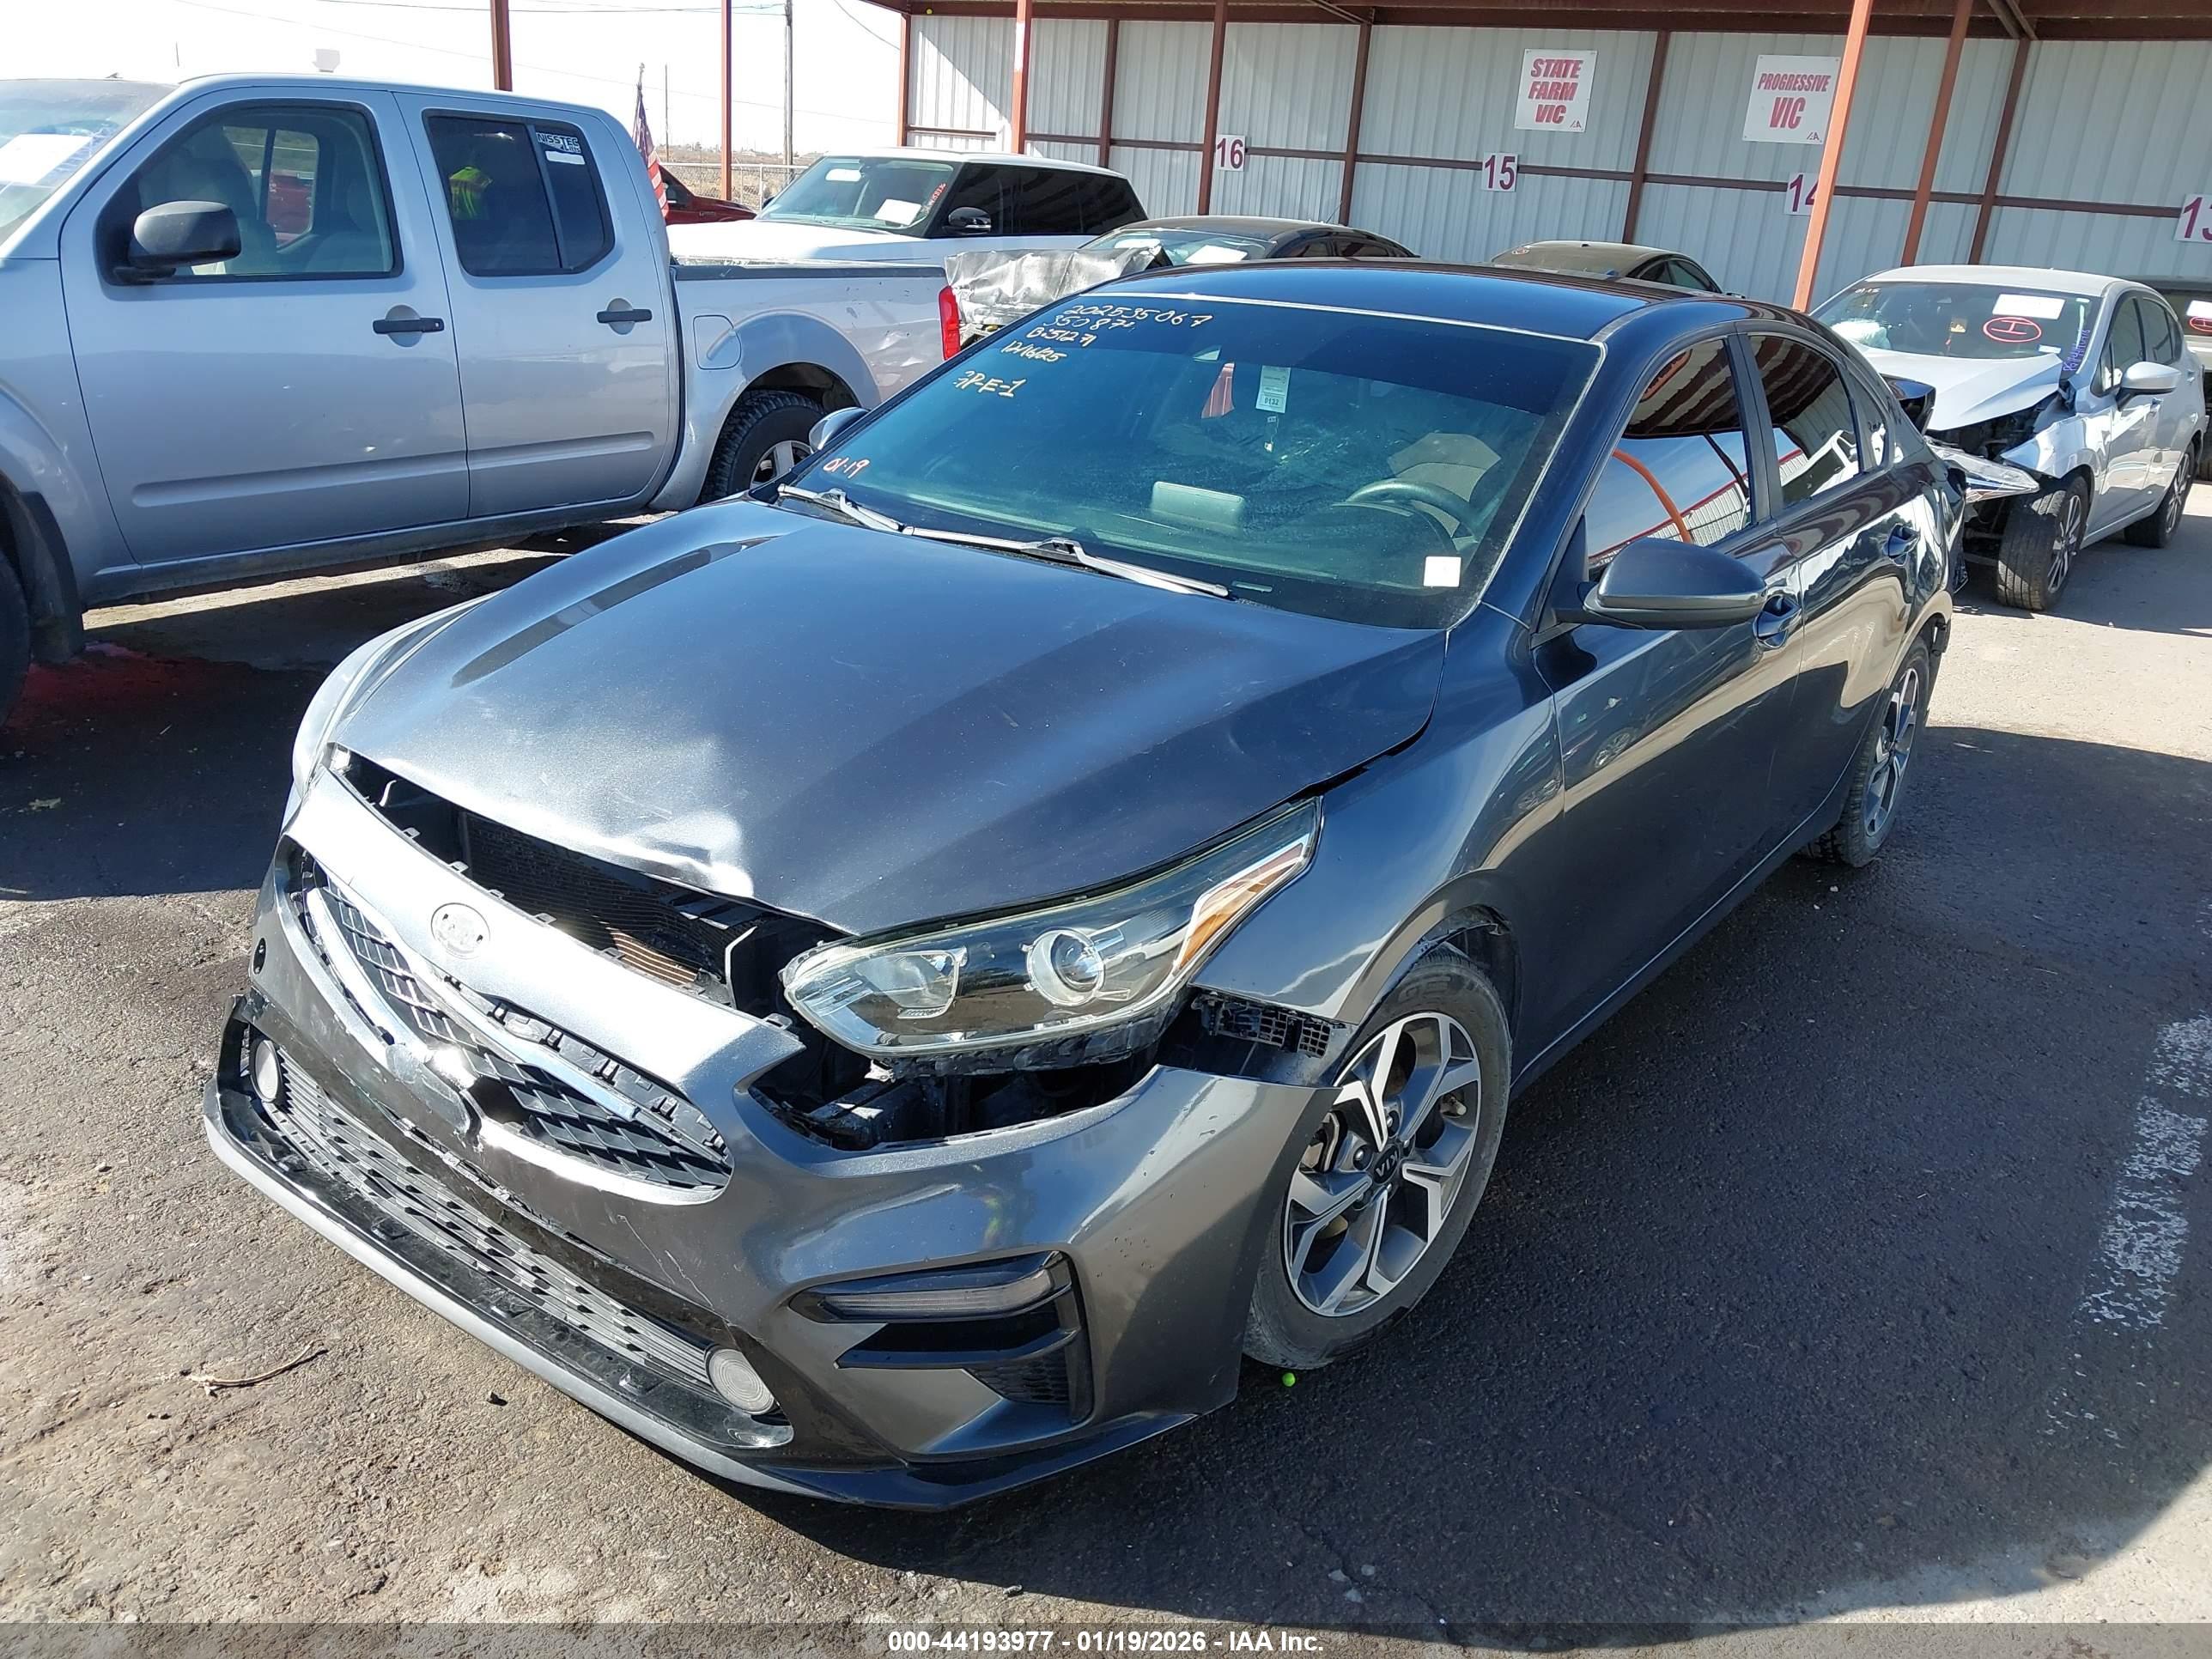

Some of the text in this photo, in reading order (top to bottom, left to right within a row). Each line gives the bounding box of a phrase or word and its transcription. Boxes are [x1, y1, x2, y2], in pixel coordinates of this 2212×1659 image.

[1530, 58, 1583, 78] STATE
[1528, 81, 1578, 100] FARM
[1758, 73, 1832, 92] PROGRESSIVE
[1535, 104, 1567, 125] VIC
[1770, 96, 1807, 130] VIC
[1217, 137, 1243, 169] 16
[1485, 155, 1516, 190] 15
[1063, 305, 1212, 328] 202535067
[1375, 1151, 1397, 1176] KIA
